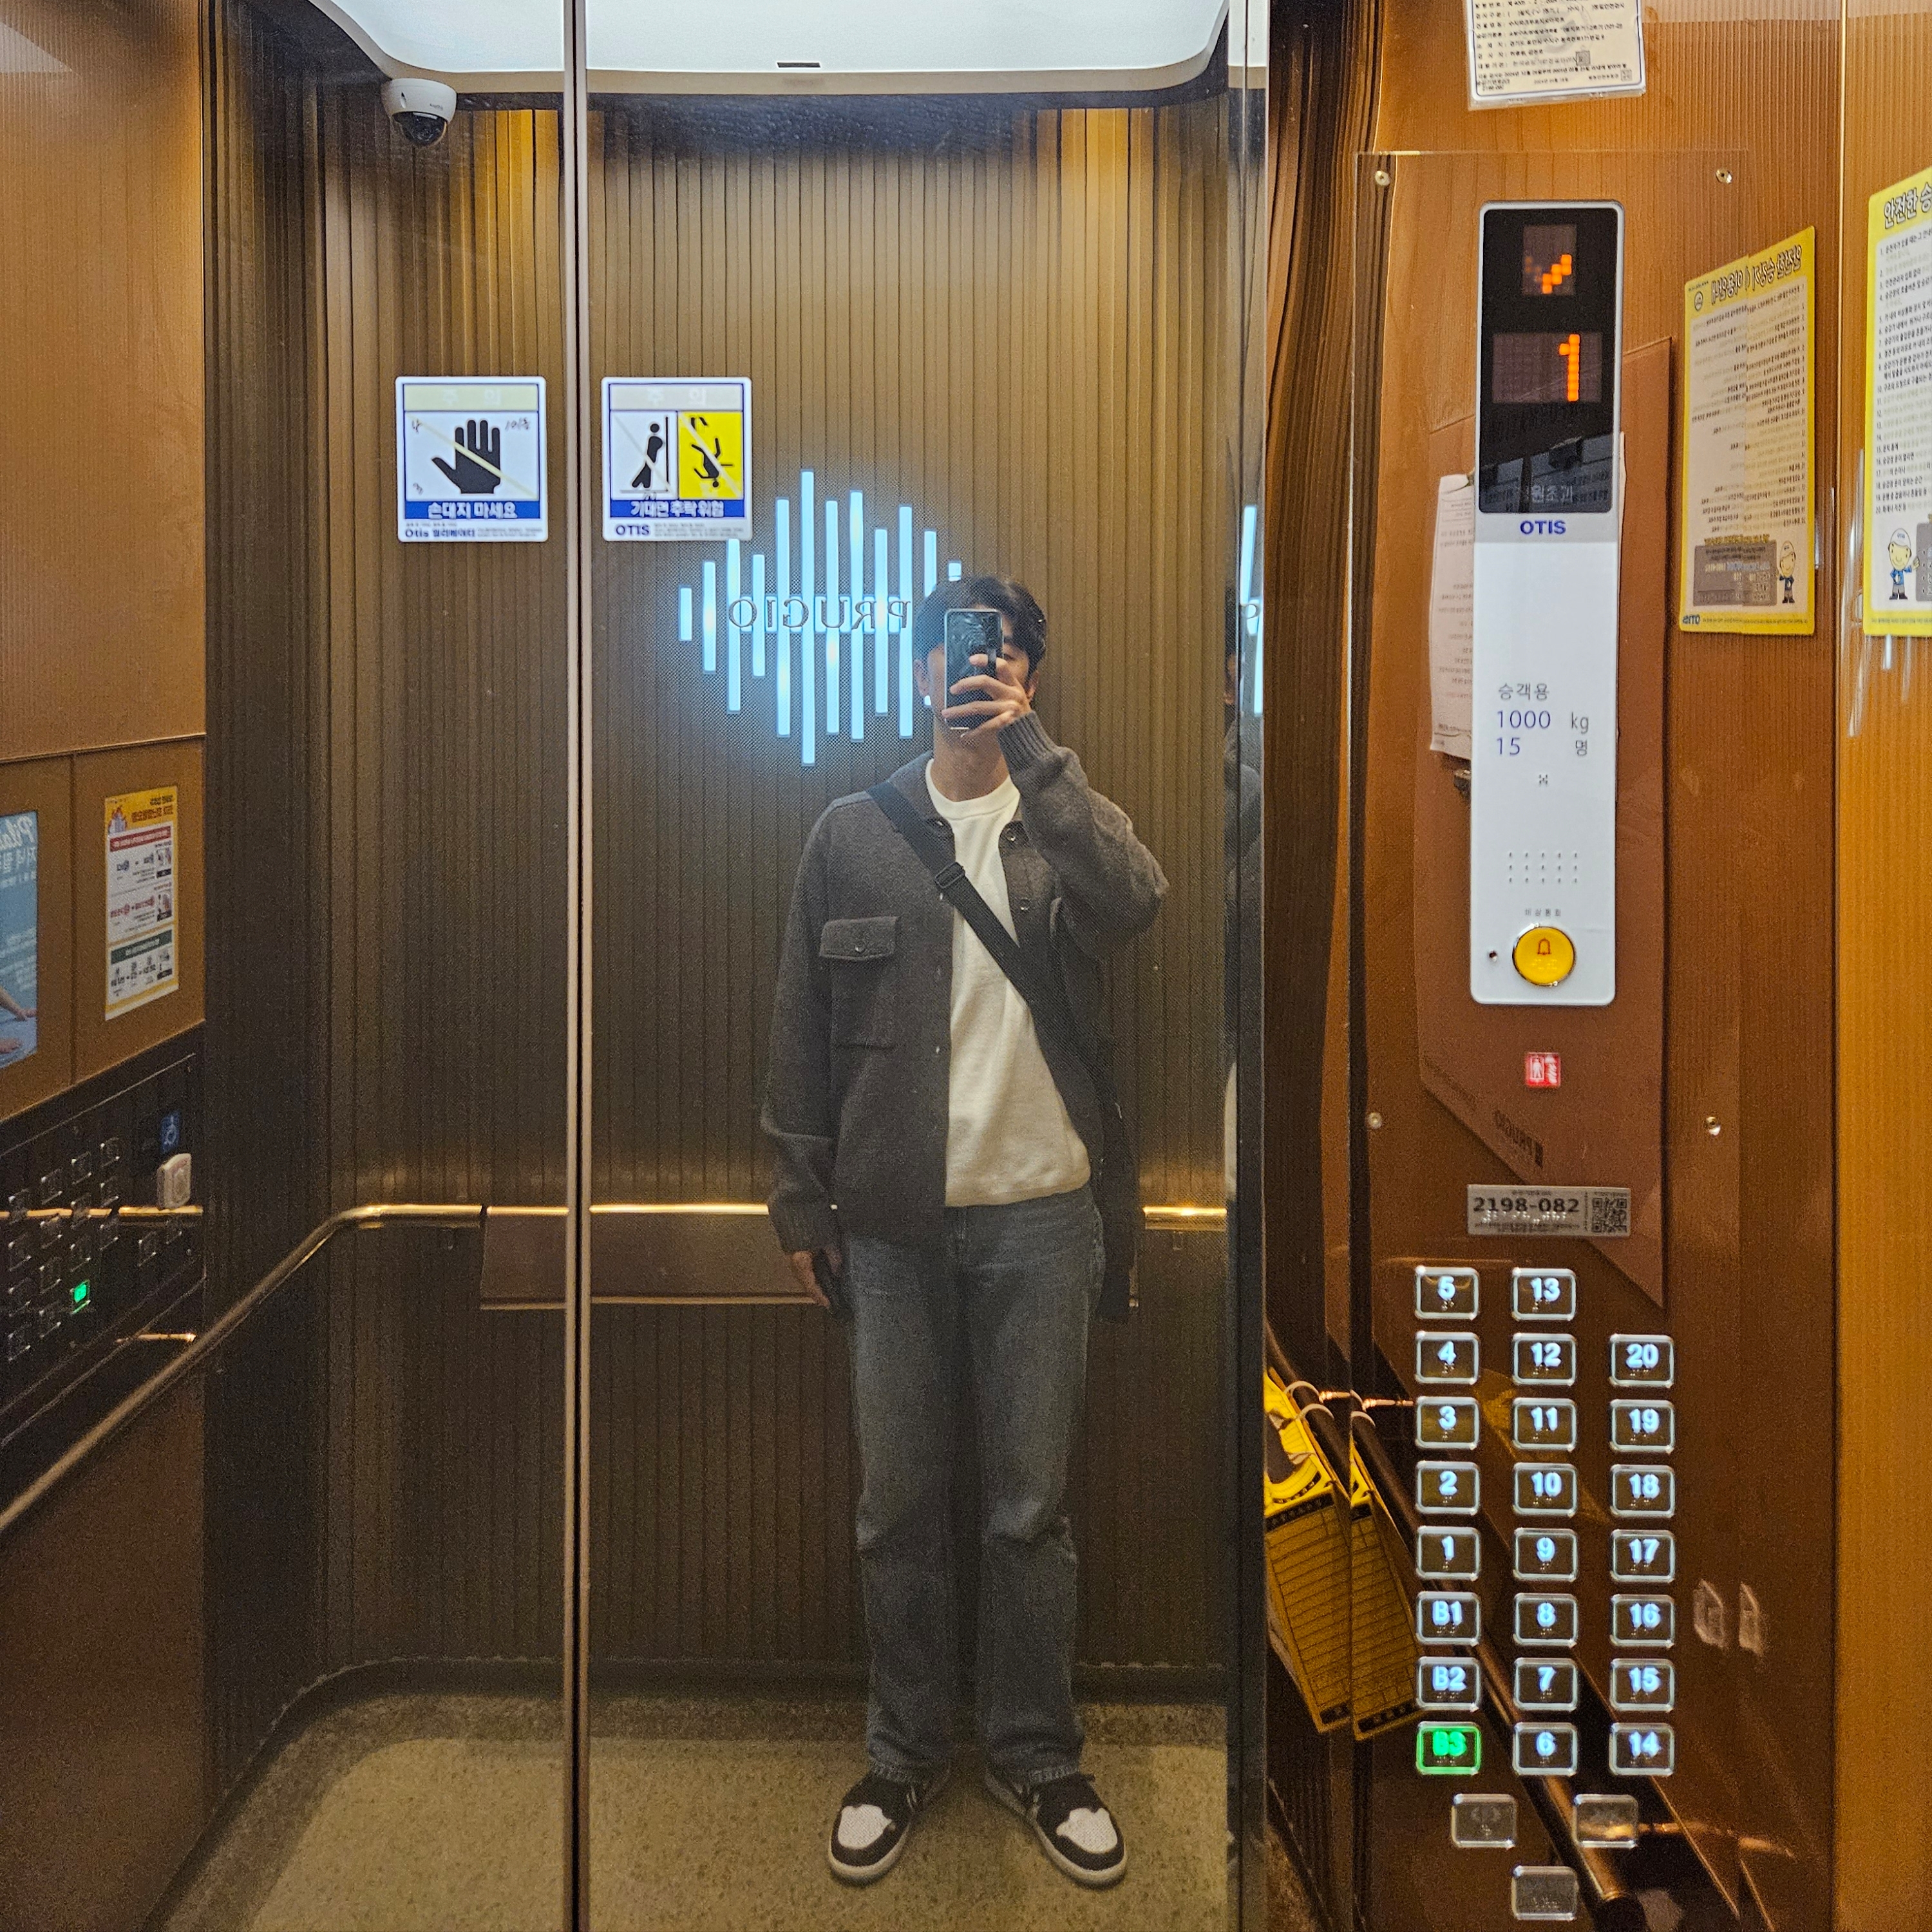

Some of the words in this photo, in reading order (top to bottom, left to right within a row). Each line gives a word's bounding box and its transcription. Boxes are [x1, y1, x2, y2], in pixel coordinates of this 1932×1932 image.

[1884, 187, 1918, 229] 안전한
[1558, 333, 1580, 403] 1
[428, 502, 471, 519] 손대지
[474, 502, 518, 519] 마세요
[630, 500, 669, 518] 기대면
[670, 500, 697, 518] 추락
[697, 500, 724, 518] 위험
[405, 529, 429, 538] Otis
[616, 525, 650, 536] OTIS
[1520, 520, 1566, 535] OTIS
[1498, 683, 1549, 701] 승객용
[1497, 710, 1551, 729] 1000
[1571, 711, 1589, 734] kg
[1497, 737, 1521, 755] 15
[1575, 739, 1588, 757] 명
[1472, 1197, 1580, 1213] 2198-082
[1437, 1276, 1455, 1301] 5
[1531, 1276, 1560, 1302] 13
[1437, 1341, 1456, 1366] 4
[1531, 1341, 1561, 1367] 12
[1626, 1343, 1659, 1368] 20
[1439, 1406, 1456, 1430] 3
[1531, 1406, 1558, 1431] 11
[1629, 1408, 1660, 1434] 19
[1439, 1470, 1457, 1495] 2
[1531, 1472, 1562, 1497] 10
[1629, 1473, 1660, 1499] 18
[1442, 1535, 1454, 1561] 1
[1537, 1537, 1555, 1562] 9
[1629, 1539, 1660, 1563] 17
[1433, 1600, 1463, 1626] B1
[1537, 1602, 1556, 1627] 8
[1630, 1602, 1661, 1628] 16
[1433, 1665, 1466, 1691] B2
[1539, 1666, 1556, 1692] 7
[1629, 1666, 1660, 1692] 15
[1432, 1731, 1466, 1757] B3
[1537, 1731, 1556, 1756] 6
[1629, 1730, 1662, 1756] 14
